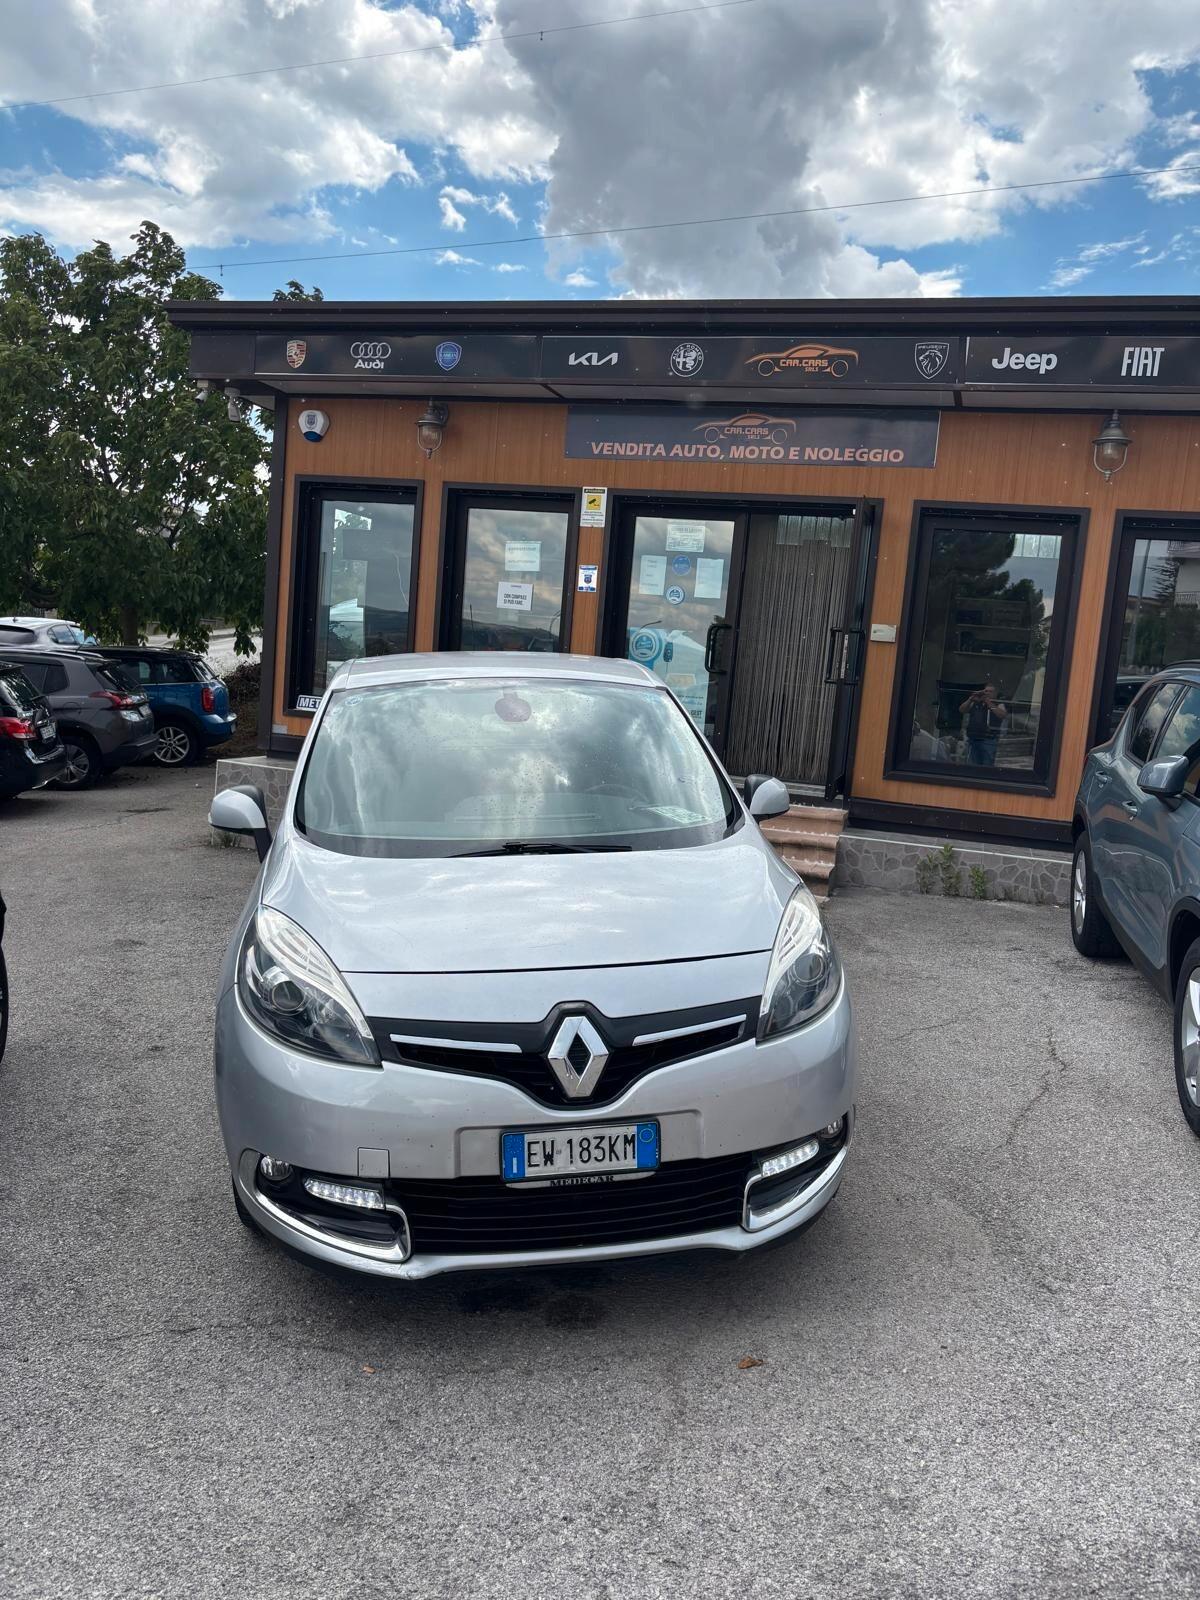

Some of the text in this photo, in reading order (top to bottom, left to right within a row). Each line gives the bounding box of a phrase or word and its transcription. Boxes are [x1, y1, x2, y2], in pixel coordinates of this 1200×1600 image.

[354, 359, 385, 369] Audi
[568, 352, 619, 366] KIA
[991, 347, 1058, 374] Jeep
[1120, 346, 1165, 377] FIAT
[591, 442, 905, 463] VENDITA AUTO, MOTO E NOLEGGIO
[527, 1133, 636, 1168] EW 183KM
